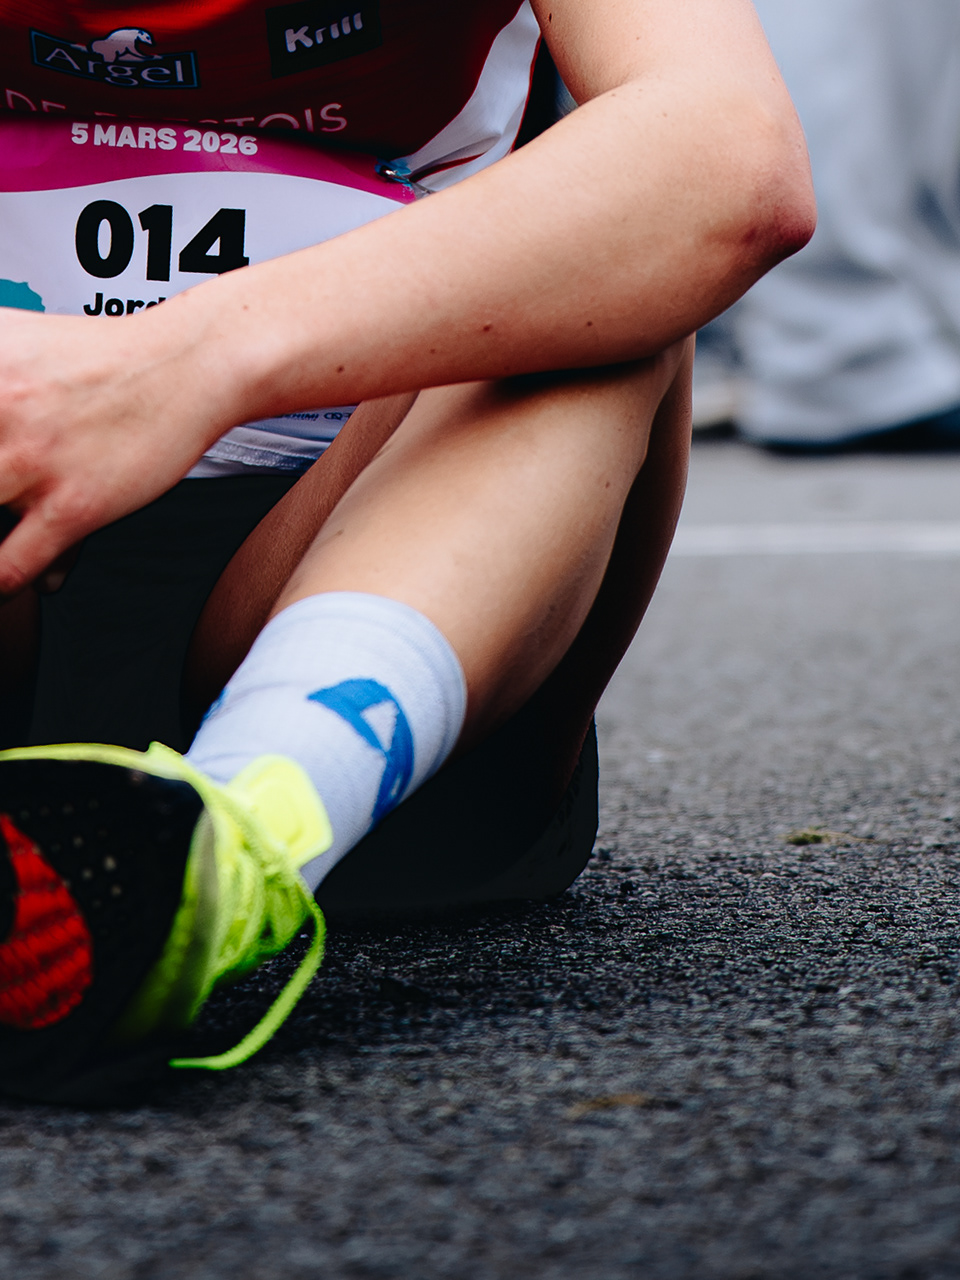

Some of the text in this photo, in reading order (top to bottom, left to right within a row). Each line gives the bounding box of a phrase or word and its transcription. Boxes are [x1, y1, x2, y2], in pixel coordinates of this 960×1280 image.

[285, 12, 363, 52] Krill
[45, 48, 184, 86] Argel
[71, 123, 258, 155] 5 MARS 2026
[75, 200, 249, 281] 014
